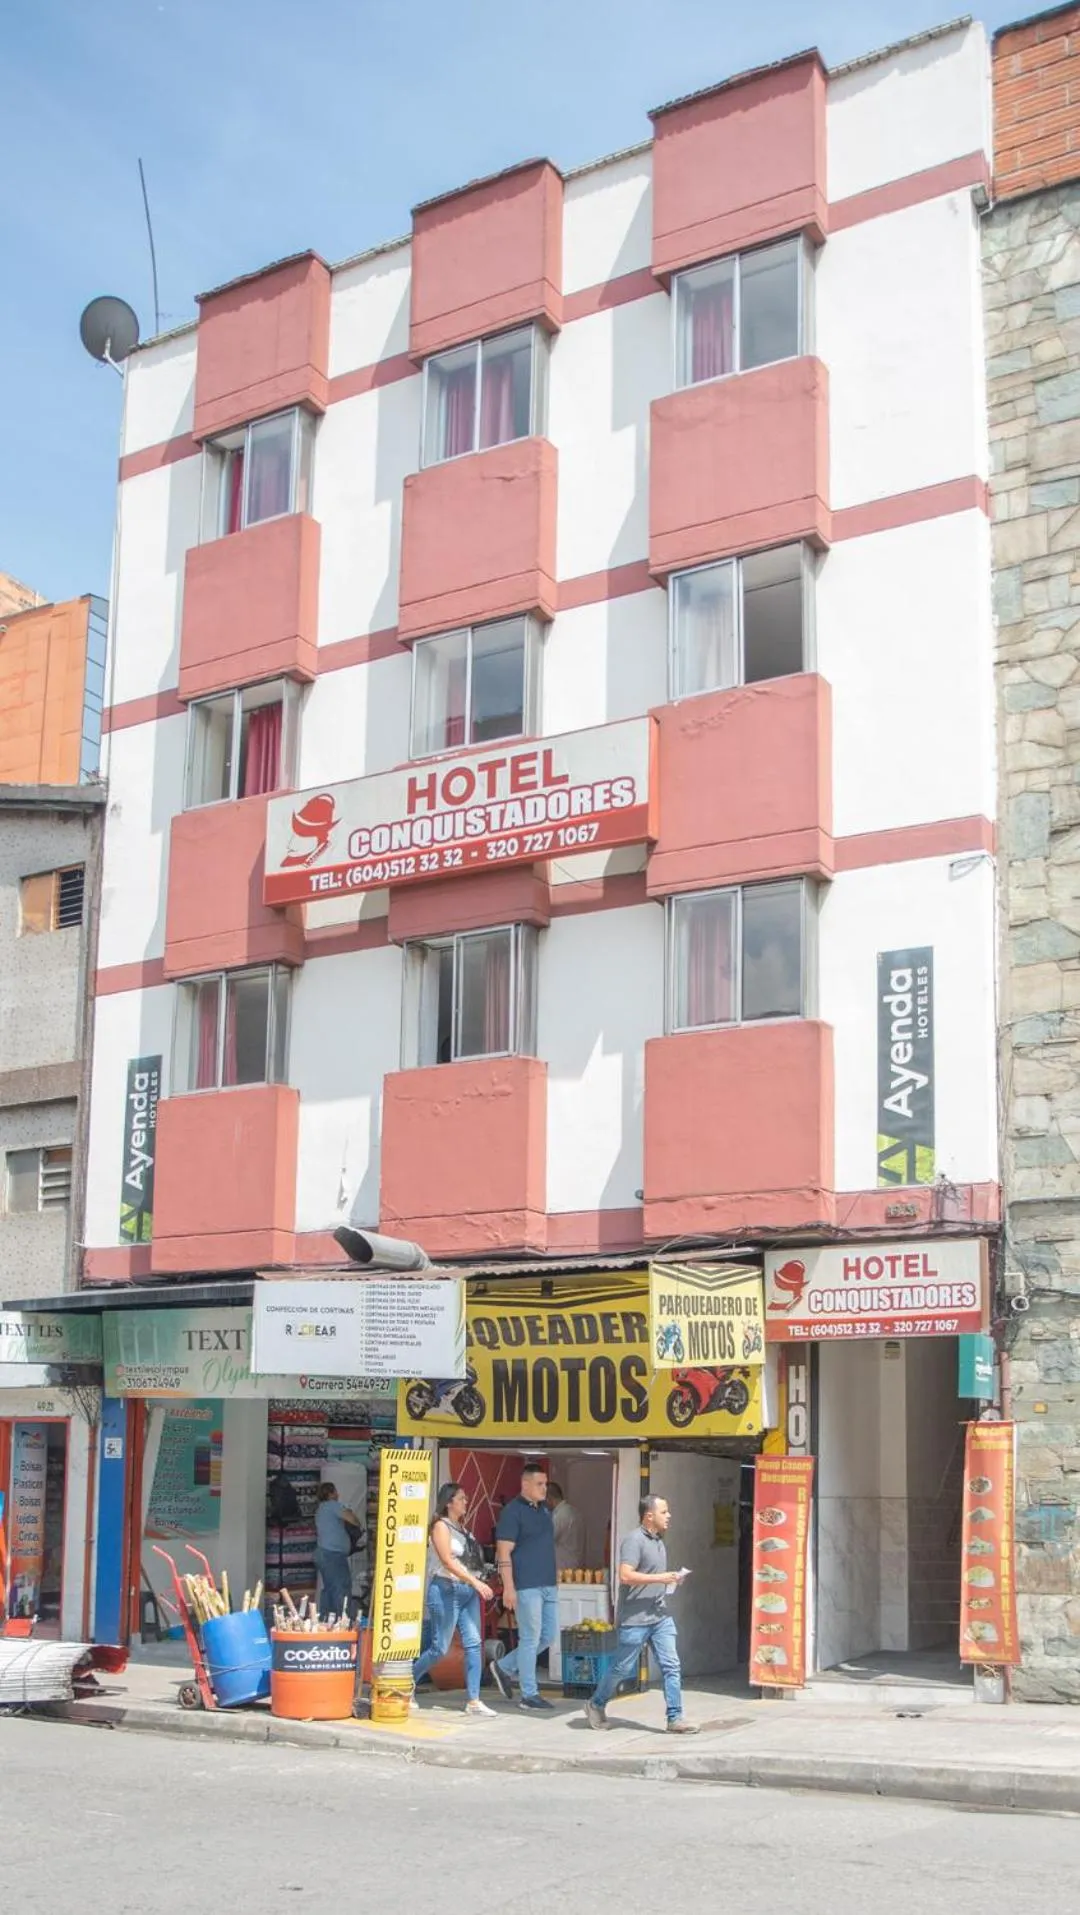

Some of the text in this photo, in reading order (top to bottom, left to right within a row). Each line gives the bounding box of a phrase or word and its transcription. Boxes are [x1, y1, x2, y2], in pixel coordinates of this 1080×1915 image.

[406, 748, 569, 816] HOTEL
[348, 776, 637, 860] CONQUISTADORES
[310, 873, 343, 893] TEL:
[345, 860, 416, 889] (604)512
[419, 854, 441, 873] 32
[443, 848, 463, 868] 32
[486, 837, 517, 863] 320
[523, 832, 553, 855] 727
[558, 824, 599, 848] 1067
[917, 965, 929, 1038] HOTELES
[883, 967, 929, 1119] Ayenda
[149, 1071, 158, 1128] HOTELES
[125, 1072, 154, 1190] Ayenda
[842, 1253, 938, 1281] HOTEL
[320, 1307, 355, 1315] CORTINAS
[659, 1294, 758, 1318] PARQUEADERO DE
[808, 1282, 975, 1314] CONQUISTADORES
[688, 1319, 735, 1360] MOTOS
[788, 1325, 809, 1337] TEL:
[810, 1322, 852, 1337] (604)512
[854, 1323, 867, 1334] 32
[868, 1322, 880, 1333] 32
[893, 1321, 912, 1333] 320
[914, 1320, 932, 1331] 727
[935, 1320, 958, 1331] 1067
[308, 1378, 344, 1390] Carrera
[492, 1354, 649, 1423] MOTOS
[788, 1365, 806, 1456] HO
[403, 1513, 419, 1525] HORA
[381, 1464, 399, 1651] PARQUEADERO
[284, 1645, 350, 1662] coéxito
